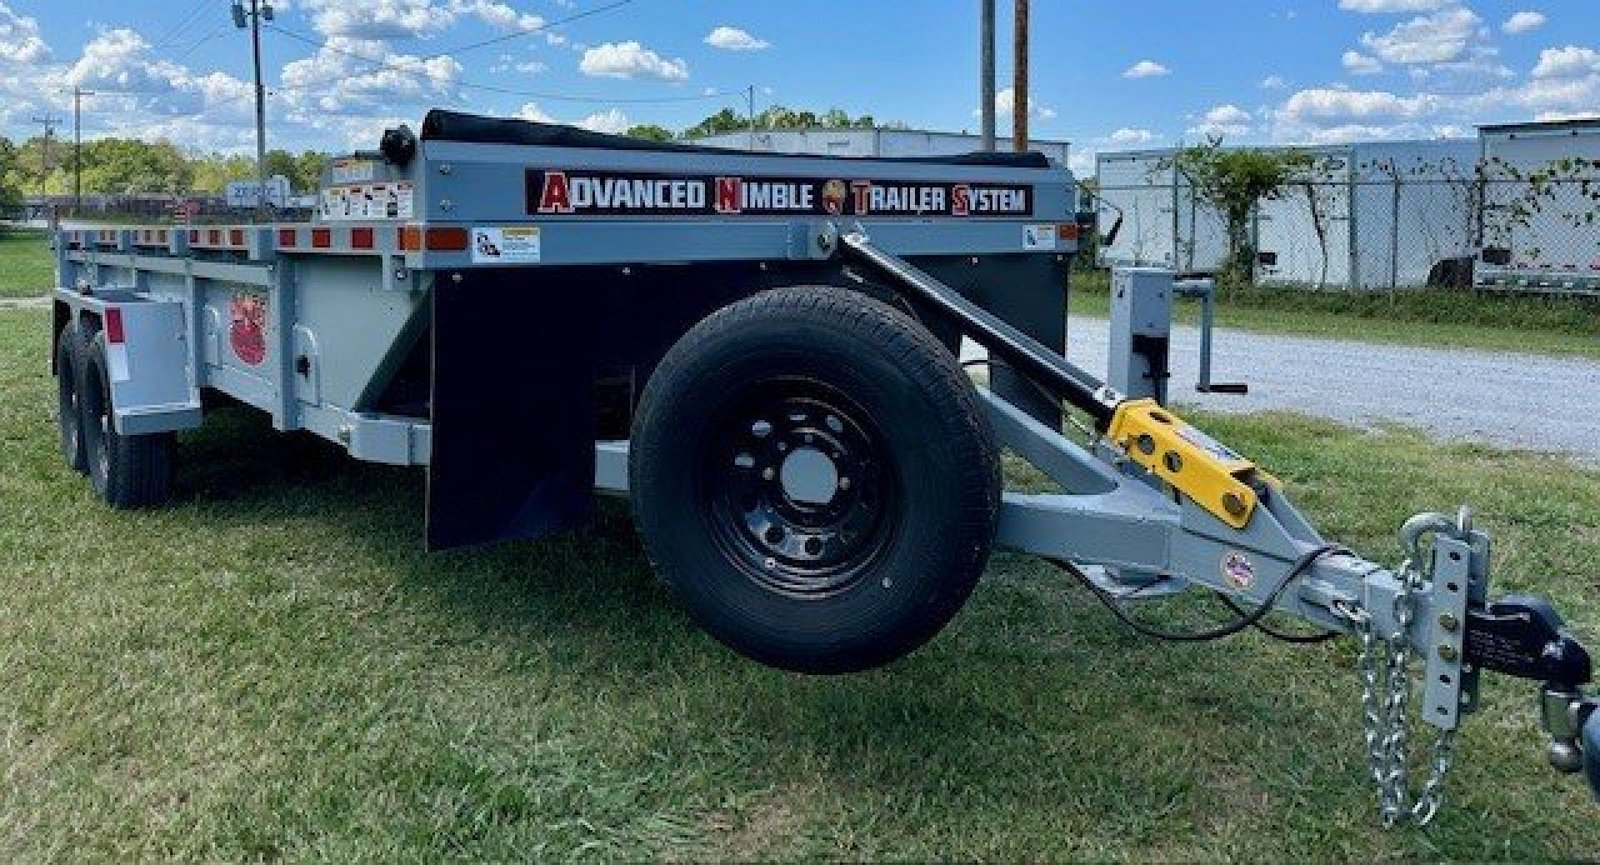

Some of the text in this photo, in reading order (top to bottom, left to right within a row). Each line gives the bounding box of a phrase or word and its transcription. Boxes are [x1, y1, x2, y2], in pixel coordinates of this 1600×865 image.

[537, 172, 1026, 215] ADVANCED NIMBLE TRAILER SYSTEM
